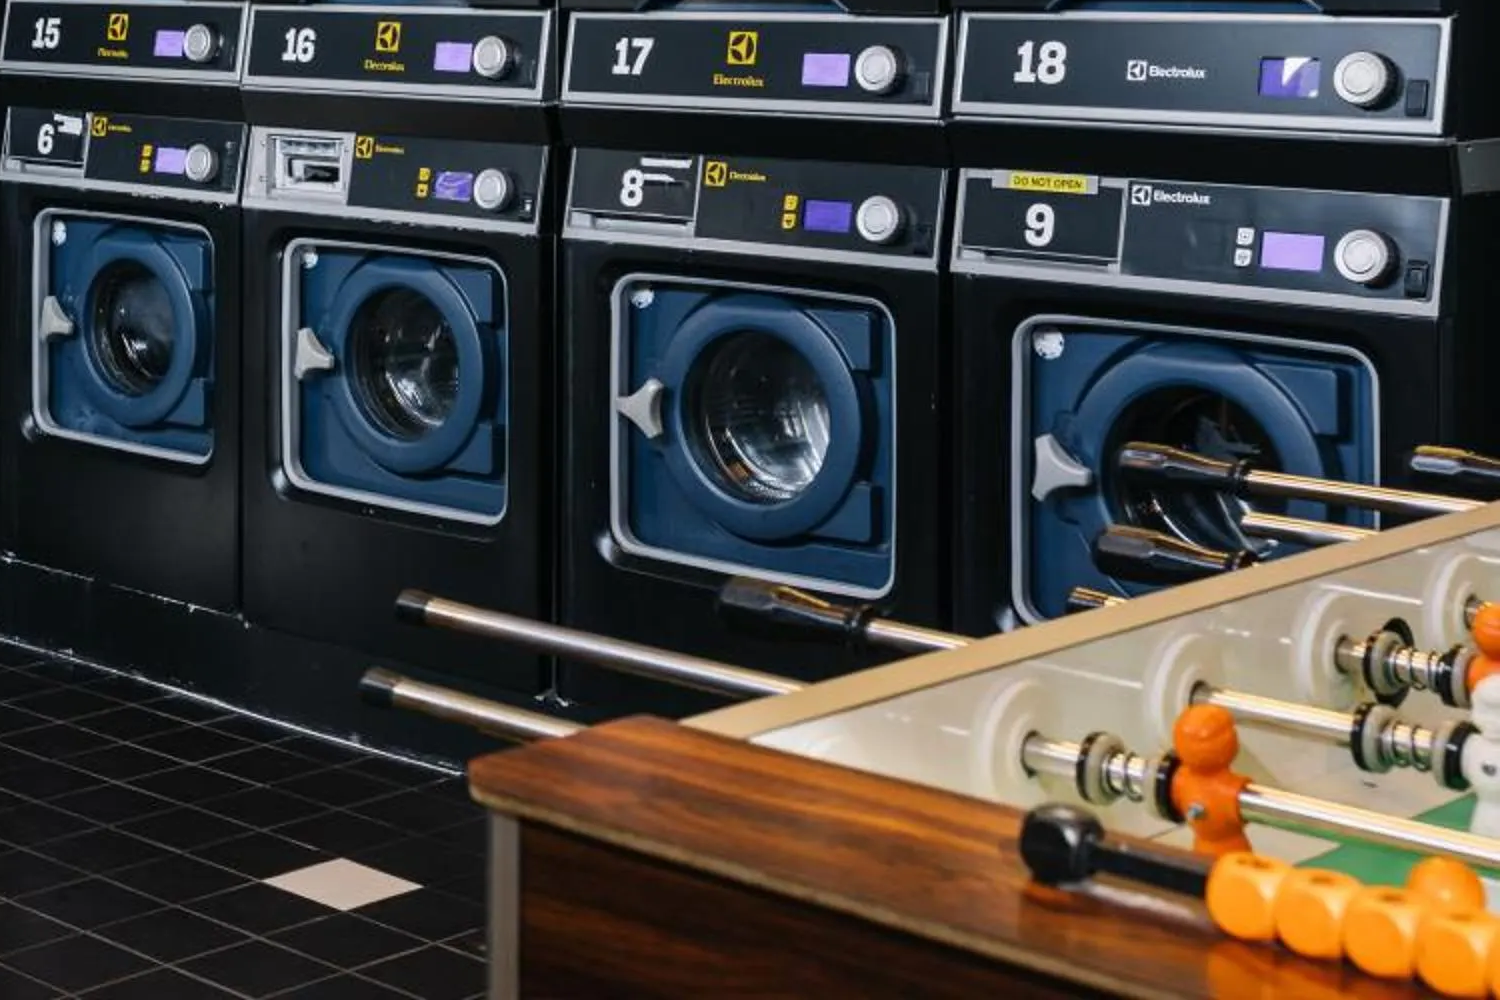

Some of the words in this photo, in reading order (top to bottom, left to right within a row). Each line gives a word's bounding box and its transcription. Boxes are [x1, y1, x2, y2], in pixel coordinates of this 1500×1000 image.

[31, 17, 61, 50] 15
[281, 27, 316, 63] 16
[611, 37, 655, 76] 17
[1013, 40, 1067, 85] 18
[1149, 65, 1207, 79] Electrolux
[713, 73, 764, 88] Electrolux
[37, 123, 55, 155] 6
[620, 168, 644, 207] 8
[1013, 175, 1029, 186] DO
[1031, 176, 1051, 187] NOT
[1053, 178, 1083, 189] OPEN
[1153, 189, 1211, 205] Electrolux
[1024, 202, 1055, 247] 9
